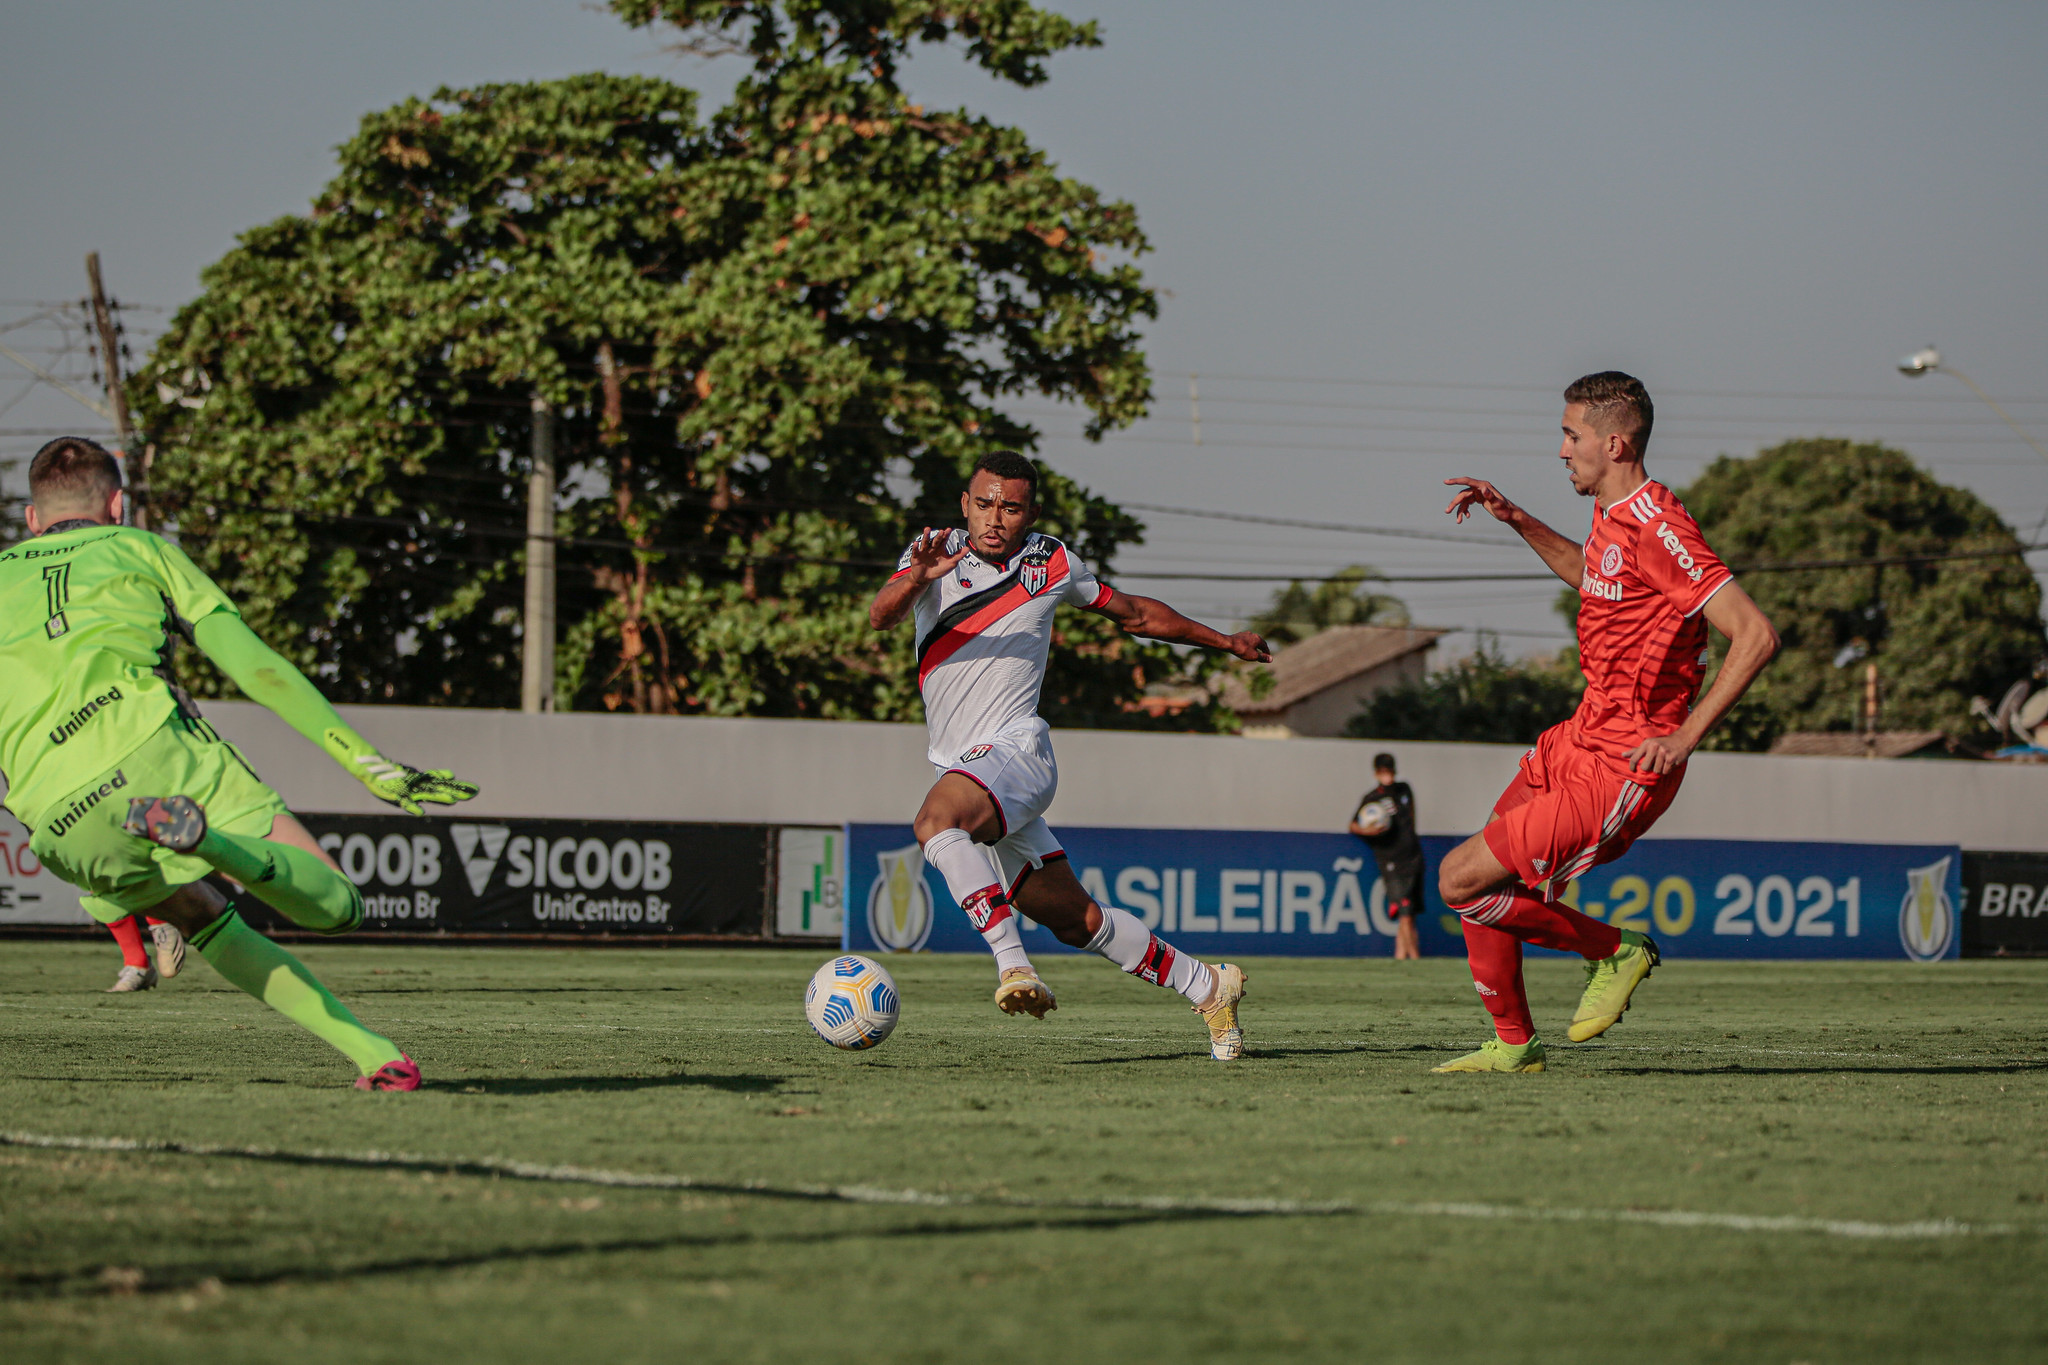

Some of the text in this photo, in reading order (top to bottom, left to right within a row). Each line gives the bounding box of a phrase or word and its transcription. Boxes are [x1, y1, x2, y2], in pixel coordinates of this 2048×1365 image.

[25, 531, 119, 560] Banri
[1656, 521, 1694, 569] vero
[42, 562, 71, 640] 1
[49, 686, 124, 746] Unimed
[505, 835, 673, 891] SICOOB
[414, 890, 441, 919] Br
[533, 892, 671, 923] UniCentro Br
[1713, 873, 1861, 938] 2021
